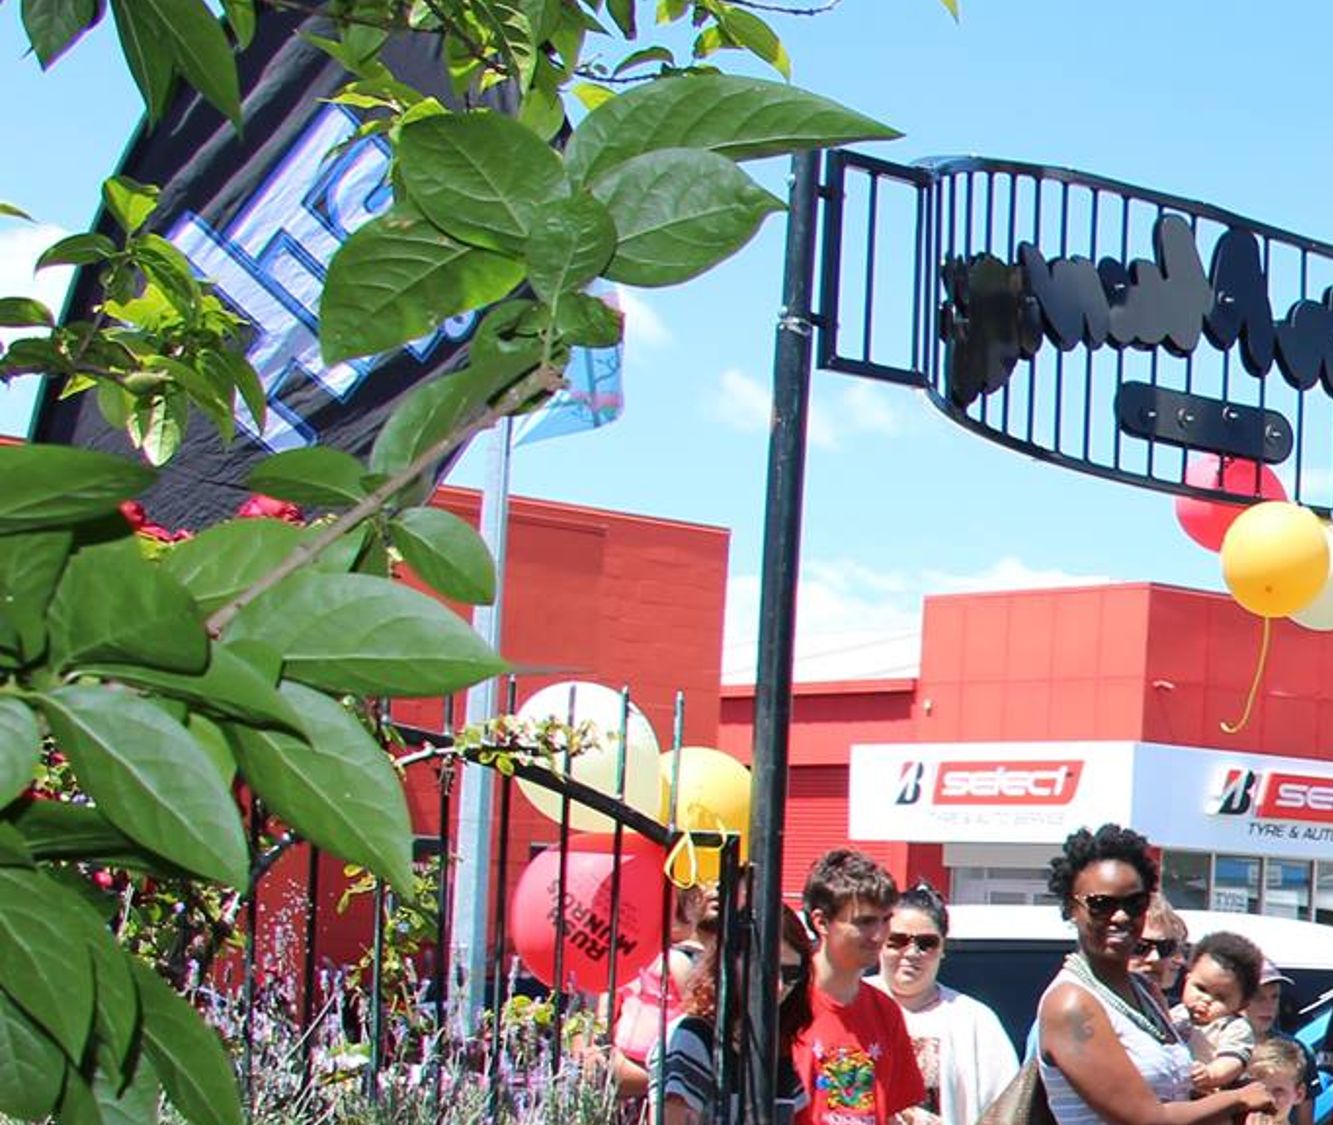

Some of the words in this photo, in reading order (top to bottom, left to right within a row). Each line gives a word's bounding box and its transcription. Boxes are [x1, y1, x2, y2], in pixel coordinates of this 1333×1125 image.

[941, 765, 1069, 797] select
[1247, 822, 1286, 838] TYRE
[1288, 826, 1299, 839] &
